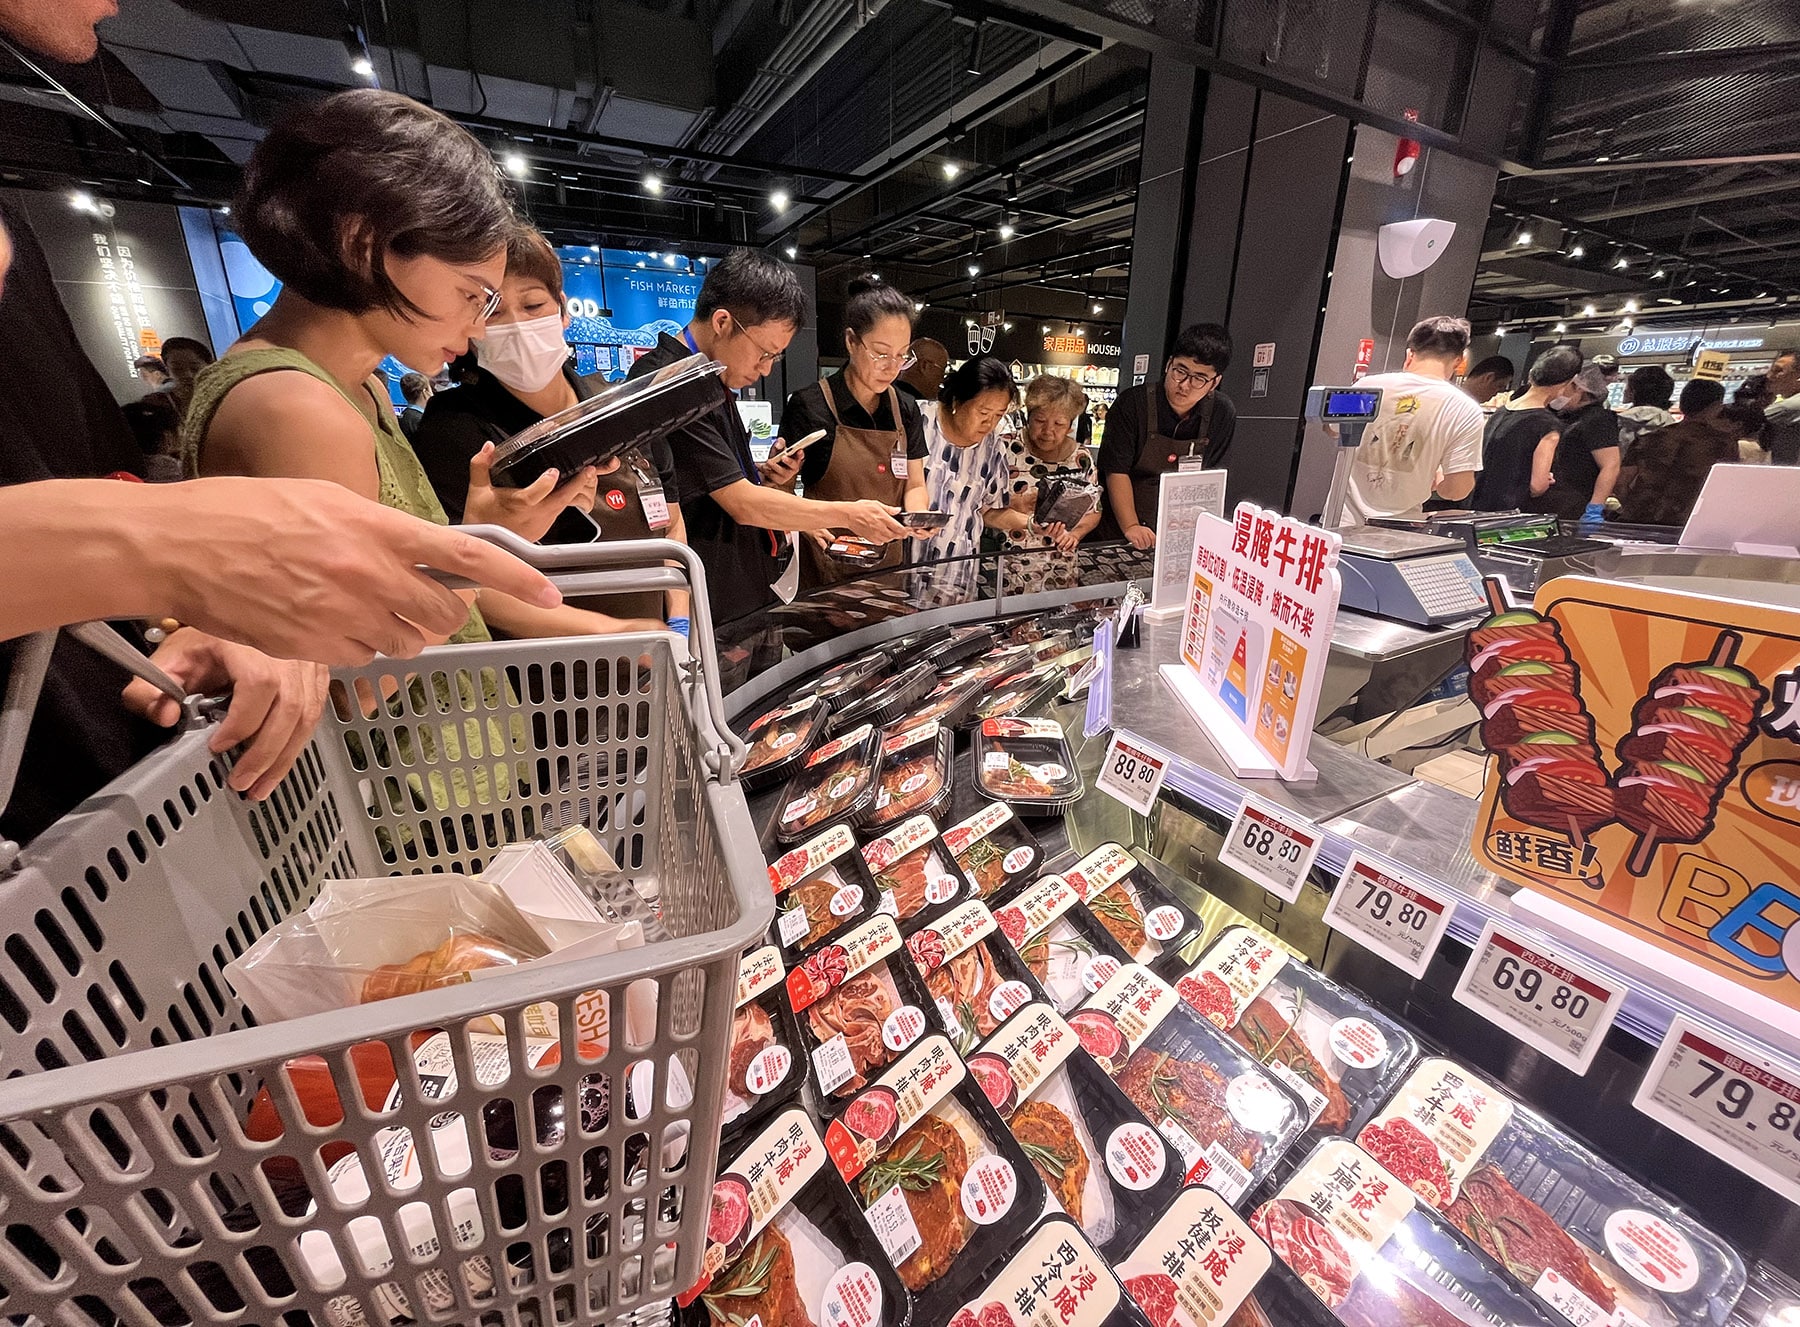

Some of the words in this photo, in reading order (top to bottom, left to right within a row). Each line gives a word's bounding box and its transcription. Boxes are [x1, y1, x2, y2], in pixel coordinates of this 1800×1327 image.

[630, 280, 654, 292] FISH
[656, 281, 697, 295] MARKET
[1043, 336, 1086, 354] 家居用品
[608, 494, 625, 505] YH
[1231, 509, 1328, 595] 浸腌牛排
[1113, 753, 1155, 785] 89.80
[1243, 822, 1302, 864] 68.80
[1354, 879, 1428, 933] 79.80
[866, 931, 894, 955] 浸腌
[1217, 935, 1261, 976] 西冷牛排
[1243, 944, 1276, 976] 浸腌
[738, 953, 775, 981] 法式羊
[1520, 950, 1576, 985] 西冷牛排
[1106, 971, 1149, 1016] 眼肉牛排
[1131, 983, 1166, 1018] 浸腌
[1492, 956, 1590, 1020] 69.80
[576, 991, 609, 1043] ESH
[1002, 1011, 1052, 1062] 眼肉牛排
[1550, 1018, 1588, 1043] 元/500g
[1029, 1027, 1064, 1064] 浸腌
[896, 1045, 945, 1094] 眼肉牛排
[918, 1058, 954, 1096] 浸腌
[1723, 1054, 1800, 1102] 眼肉牛排
[1413, 1070, 1465, 1127] 西冷牛排
[749, 1120, 804, 1183] 眼肉牛排
[775, 1138, 812, 1186] 浸腌
[1193, 1164, 1212, 1181] SAL
[1420, 1183, 1437, 1199] 今日
[1161, 1206, 1224, 1280] 板健牛排
[1198, 1228, 1246, 1287] 浸腌
[1014, 1239, 1079, 1317] 西冷牛排
[1050, 1263, 1098, 1326] 浸腌
[1308, 1277, 1326, 1296] 今日
